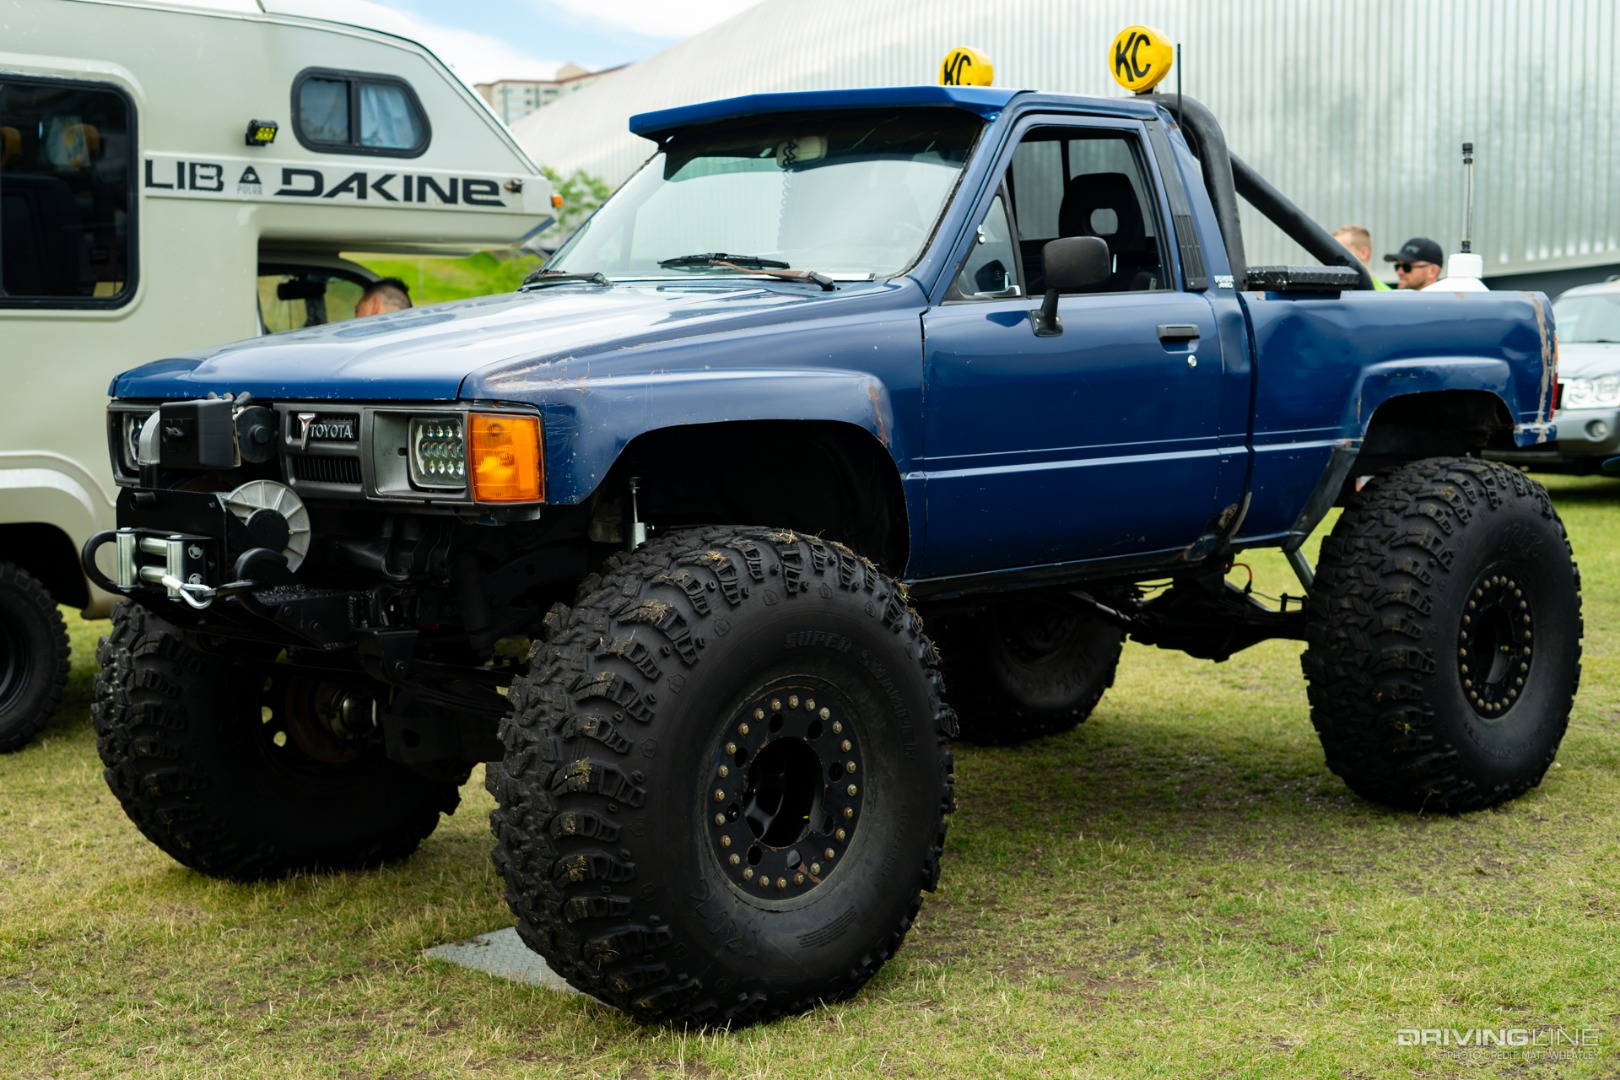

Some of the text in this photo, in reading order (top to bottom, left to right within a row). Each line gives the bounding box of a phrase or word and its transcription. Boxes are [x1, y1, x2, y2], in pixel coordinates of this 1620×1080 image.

[943, 52, 972, 85] KC
[1115, 32, 1152, 82] KC
[145, 159, 224, 191] LIB
[310, 423, 353, 439] TOYOTA
[784, 631, 917, 761] SUPER SWAMPER
